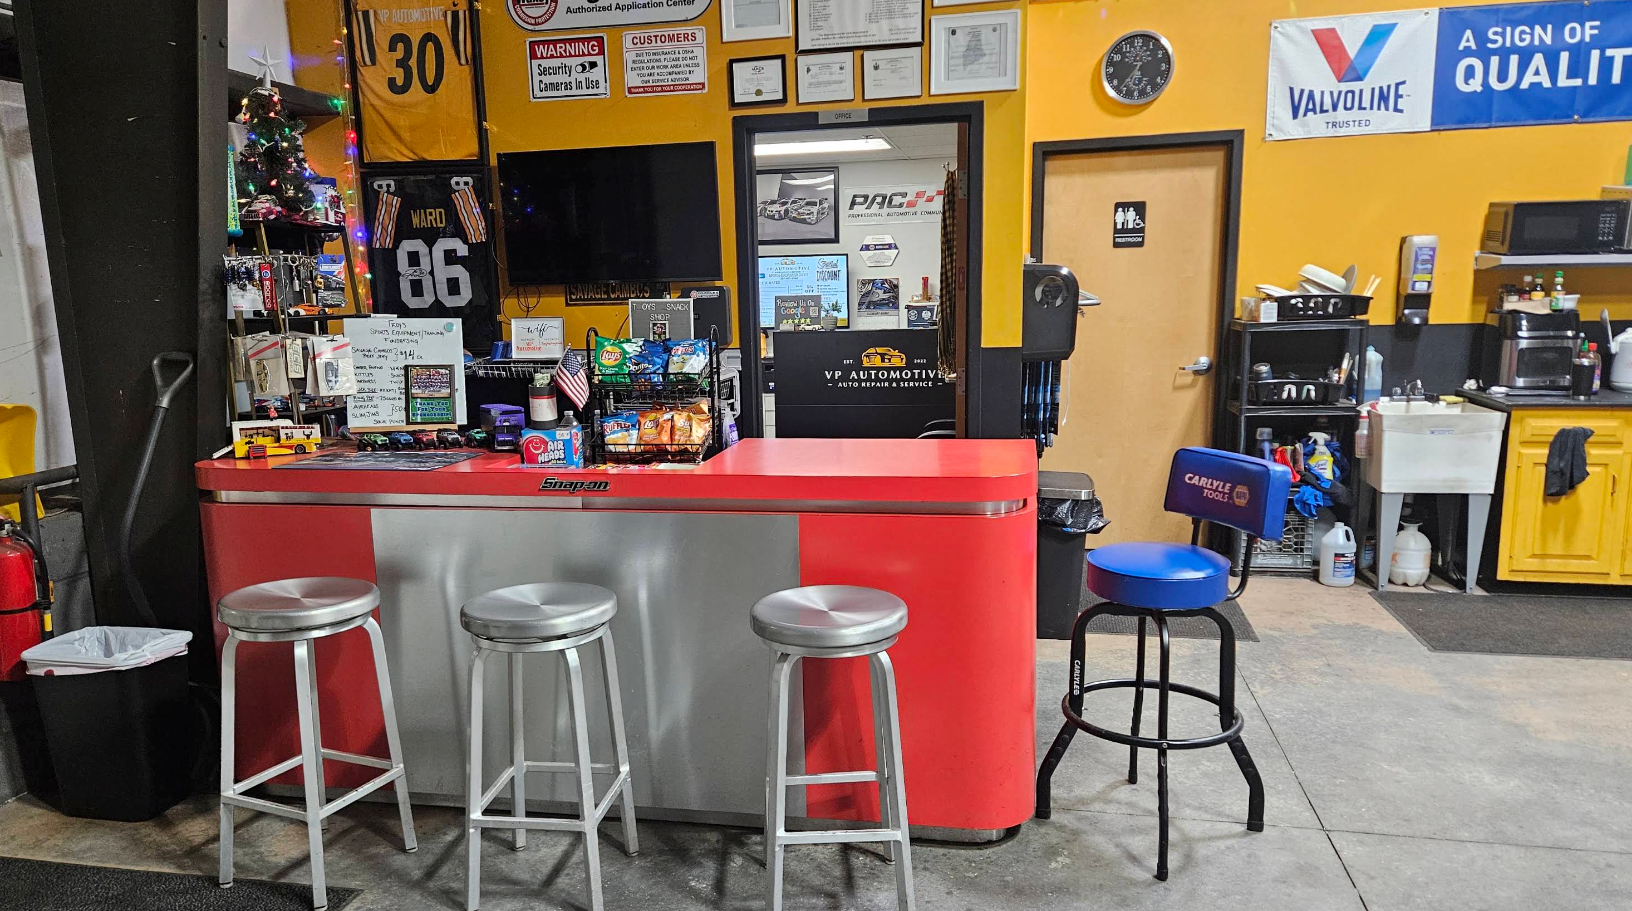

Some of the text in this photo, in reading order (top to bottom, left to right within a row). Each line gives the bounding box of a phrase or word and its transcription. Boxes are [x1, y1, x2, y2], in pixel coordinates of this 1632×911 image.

[392, 6, 444, 22] AUTOMOTIVE
[566, 4, 612, 14] Authorized
[614, 1, 664, 12] Application
[632, 32, 697, 46] CUSTOMERS
[1458, 21, 1600, 50] A SIGN OF
[535, 42, 598, 58] WARNING
[388, 32, 444, 95] 30
[538, 62, 572, 77] Security
[539, 80, 572, 92] Cameras
[575, 78, 583, 90] In
[585, 77, 600, 89] Use
[1289, 80, 1406, 120] VALVOLINE
[1326, 120, 1371, 129] TRUSTED
[848, 192, 908, 210] PAC
[411, 208, 446, 228] WARD
[397, 238, 472, 308] 86
[816, 270, 841, 282] DISCOUNT
[571, 284, 607, 299] SAVAGE
[781, 307, 805, 318] Google
[825, 371, 842, 379] VP
[548, 440, 564, 451] AIR
[538, 450, 565, 463] HEADS
[540, 477, 610, 492] Snap-on
[1185, 473, 1231, 493] CARLYLE
[1203, 488, 1228, 502] TOOLS
